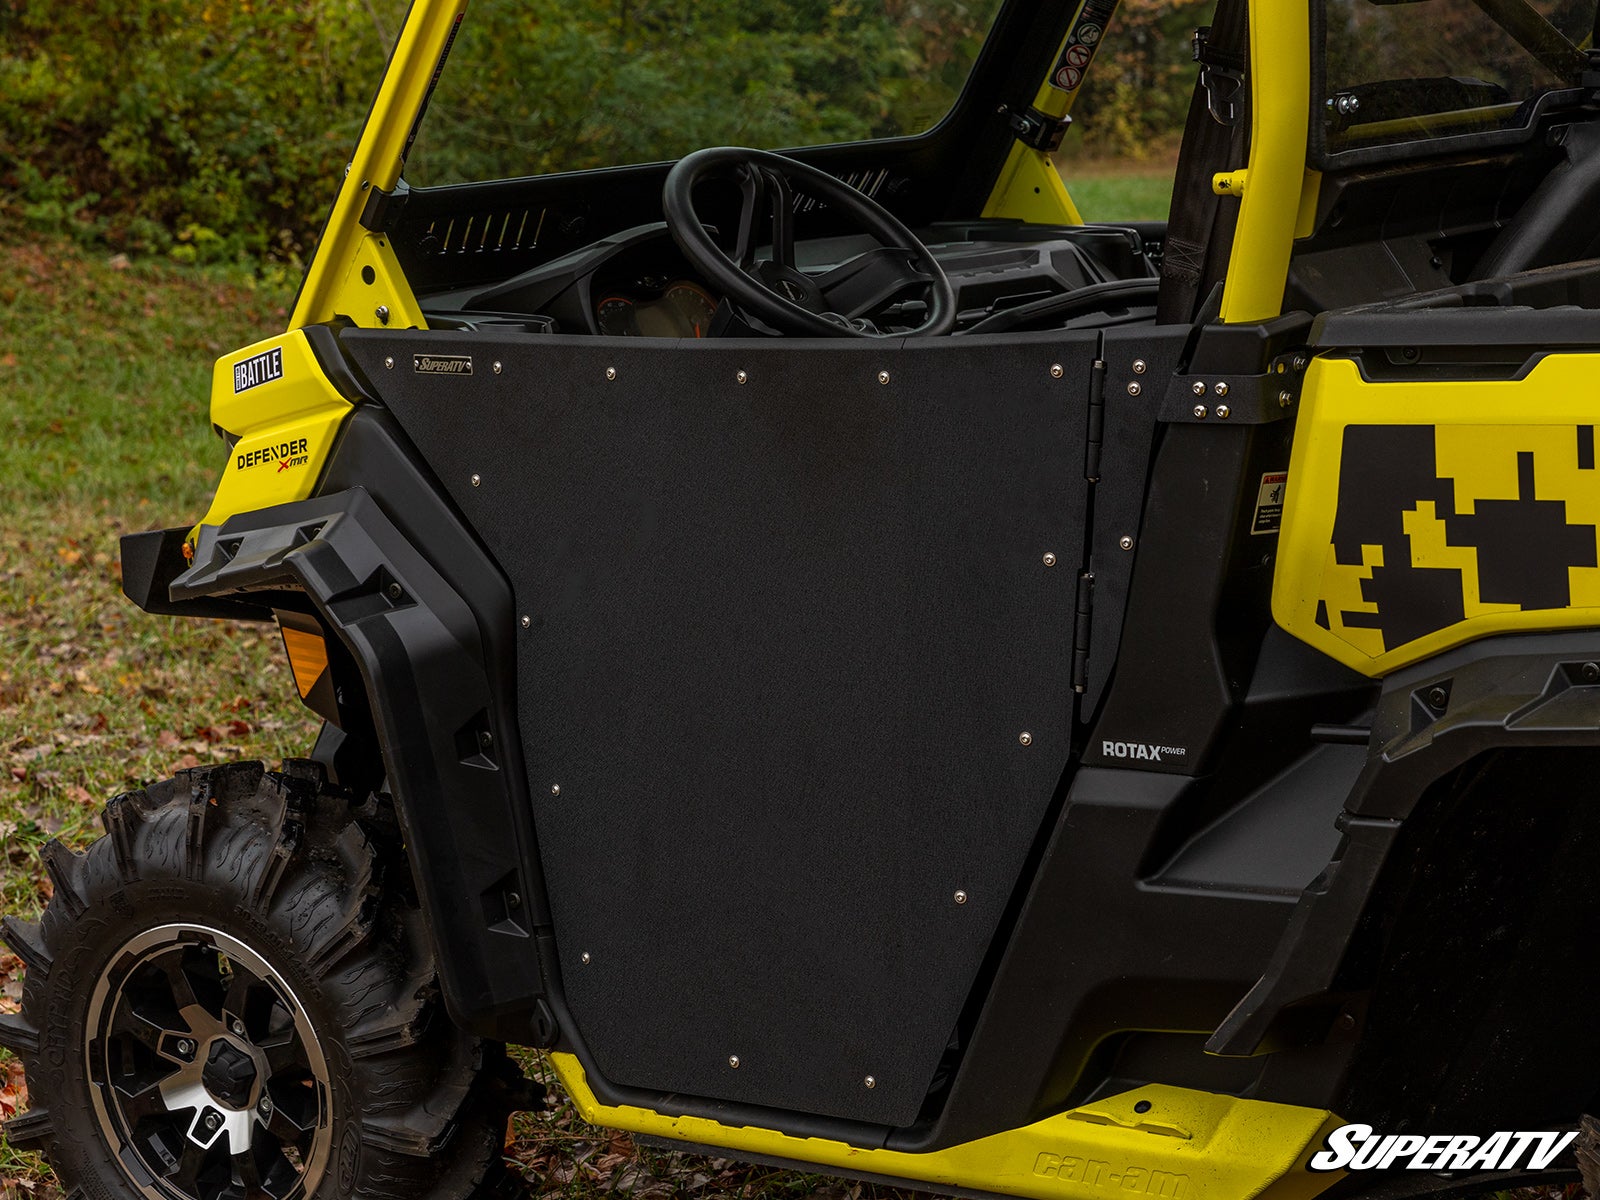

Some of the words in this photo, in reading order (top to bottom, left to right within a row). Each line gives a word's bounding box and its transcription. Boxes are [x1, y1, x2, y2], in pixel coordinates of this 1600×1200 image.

[240, 351, 280, 388] BATTLE
[419, 357, 467, 372] SUPERATV
[237, 438, 307, 470] DEFENDER
[1102, 740, 1161, 761] ROTAX
[1161, 746, 1186, 756] POWER
